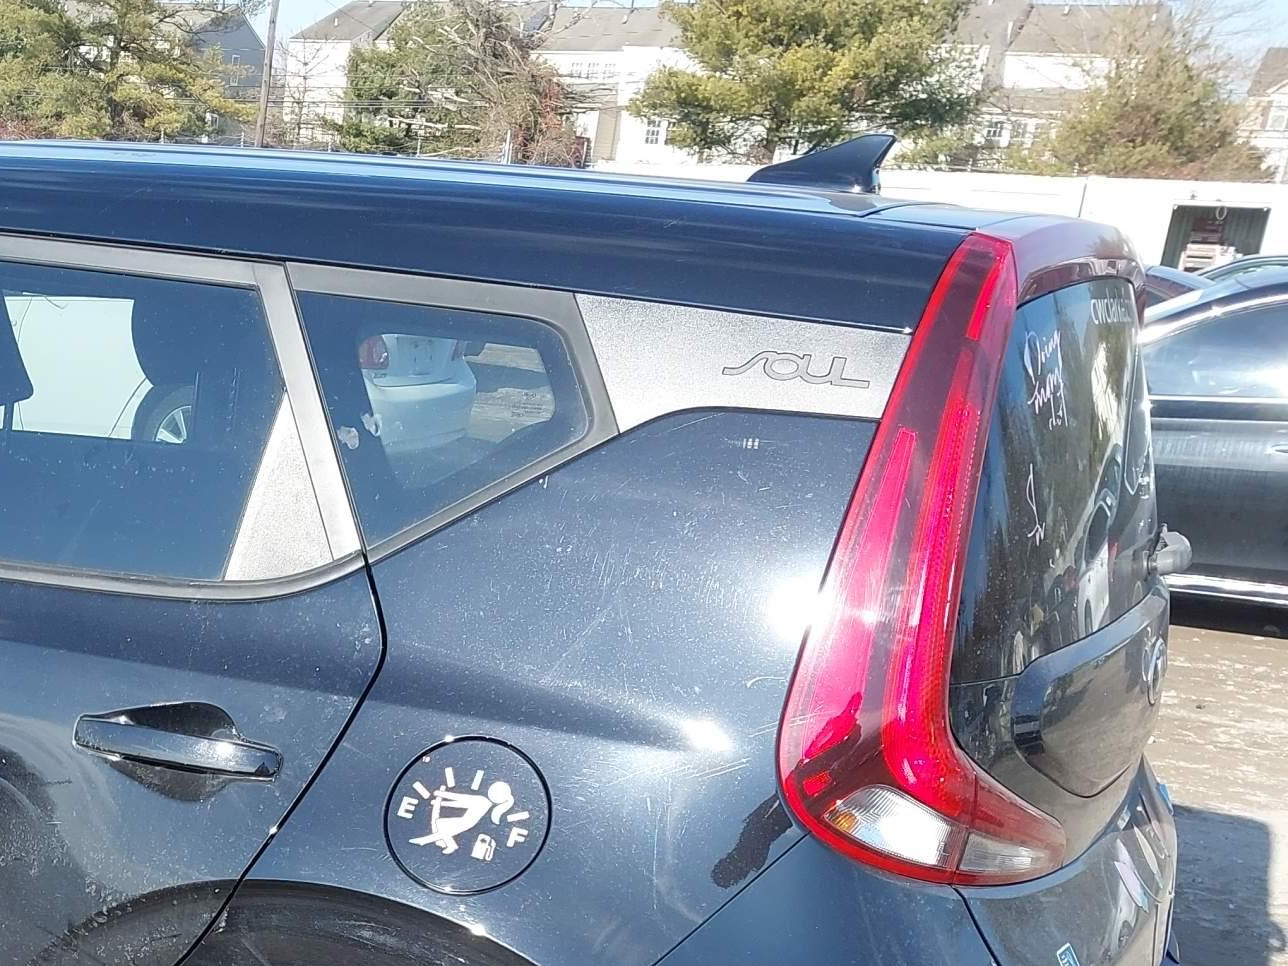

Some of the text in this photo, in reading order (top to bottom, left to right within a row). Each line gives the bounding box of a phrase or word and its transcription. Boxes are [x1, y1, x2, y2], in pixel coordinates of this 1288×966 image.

[722, 350, 870, 389] SOUL
[397, 796, 419, 819] E
[506, 827, 528, 847] F
